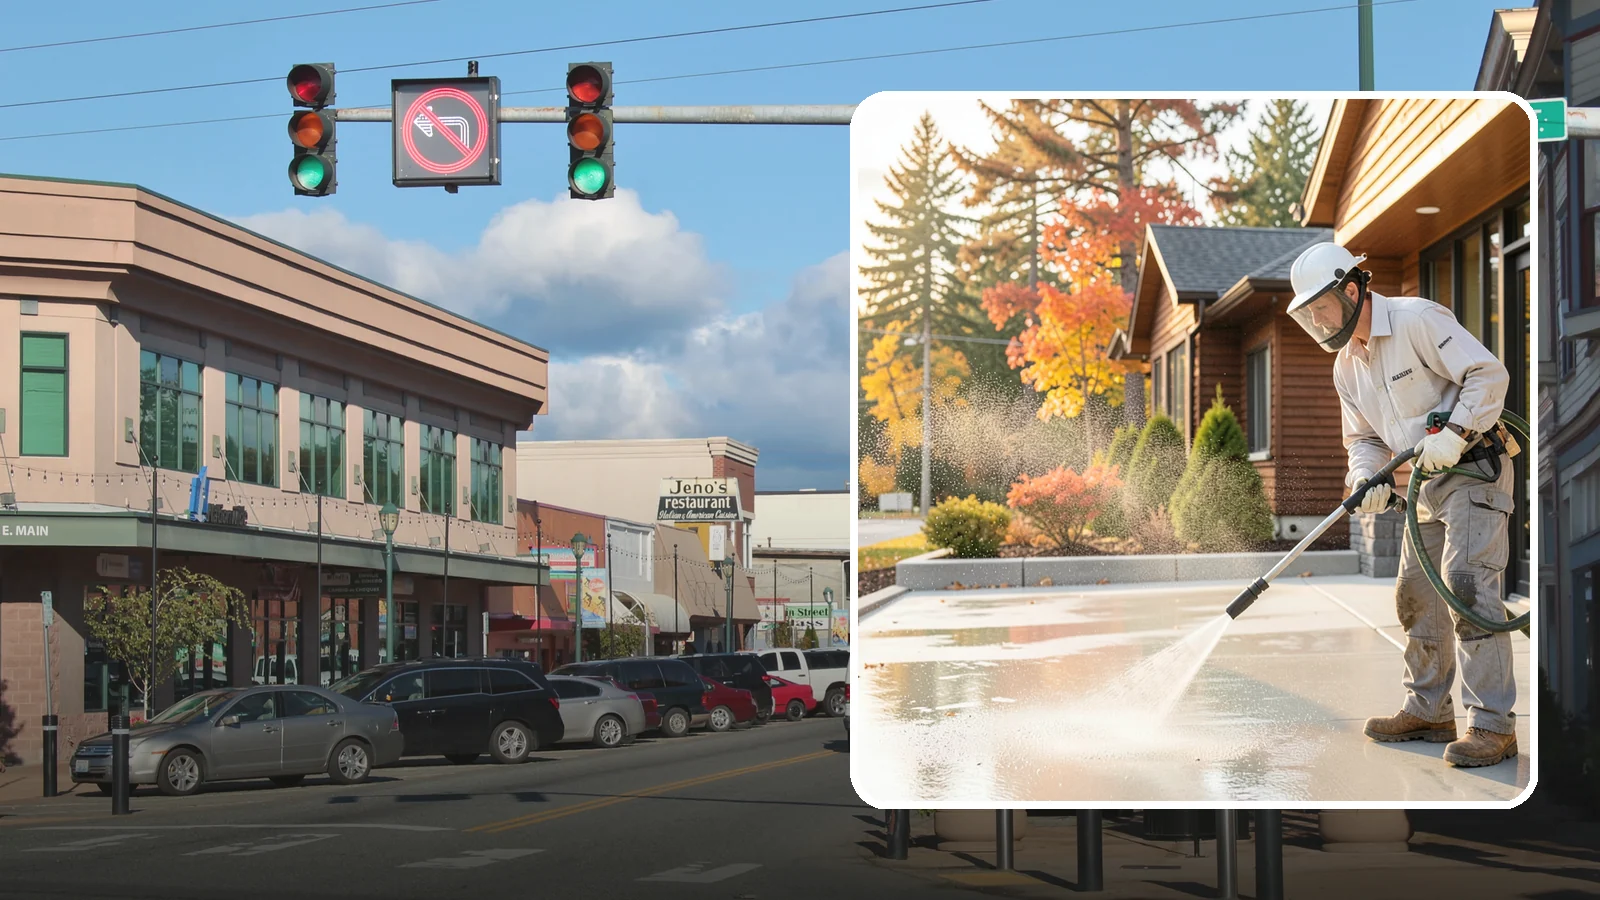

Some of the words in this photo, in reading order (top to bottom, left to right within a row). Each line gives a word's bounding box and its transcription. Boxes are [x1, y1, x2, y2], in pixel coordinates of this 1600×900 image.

[669, 479, 727, 495] Jeno's
[665, 496, 731, 509] restaurant
[658, 509, 682, 519] Italian
[686, 509, 715, 519] American
[715, 509, 737, 519] Cuisine
[2, 525, 13, 536] E.
[15, 525, 49, 536] MAIN
[797, 607, 828, 617] Street
